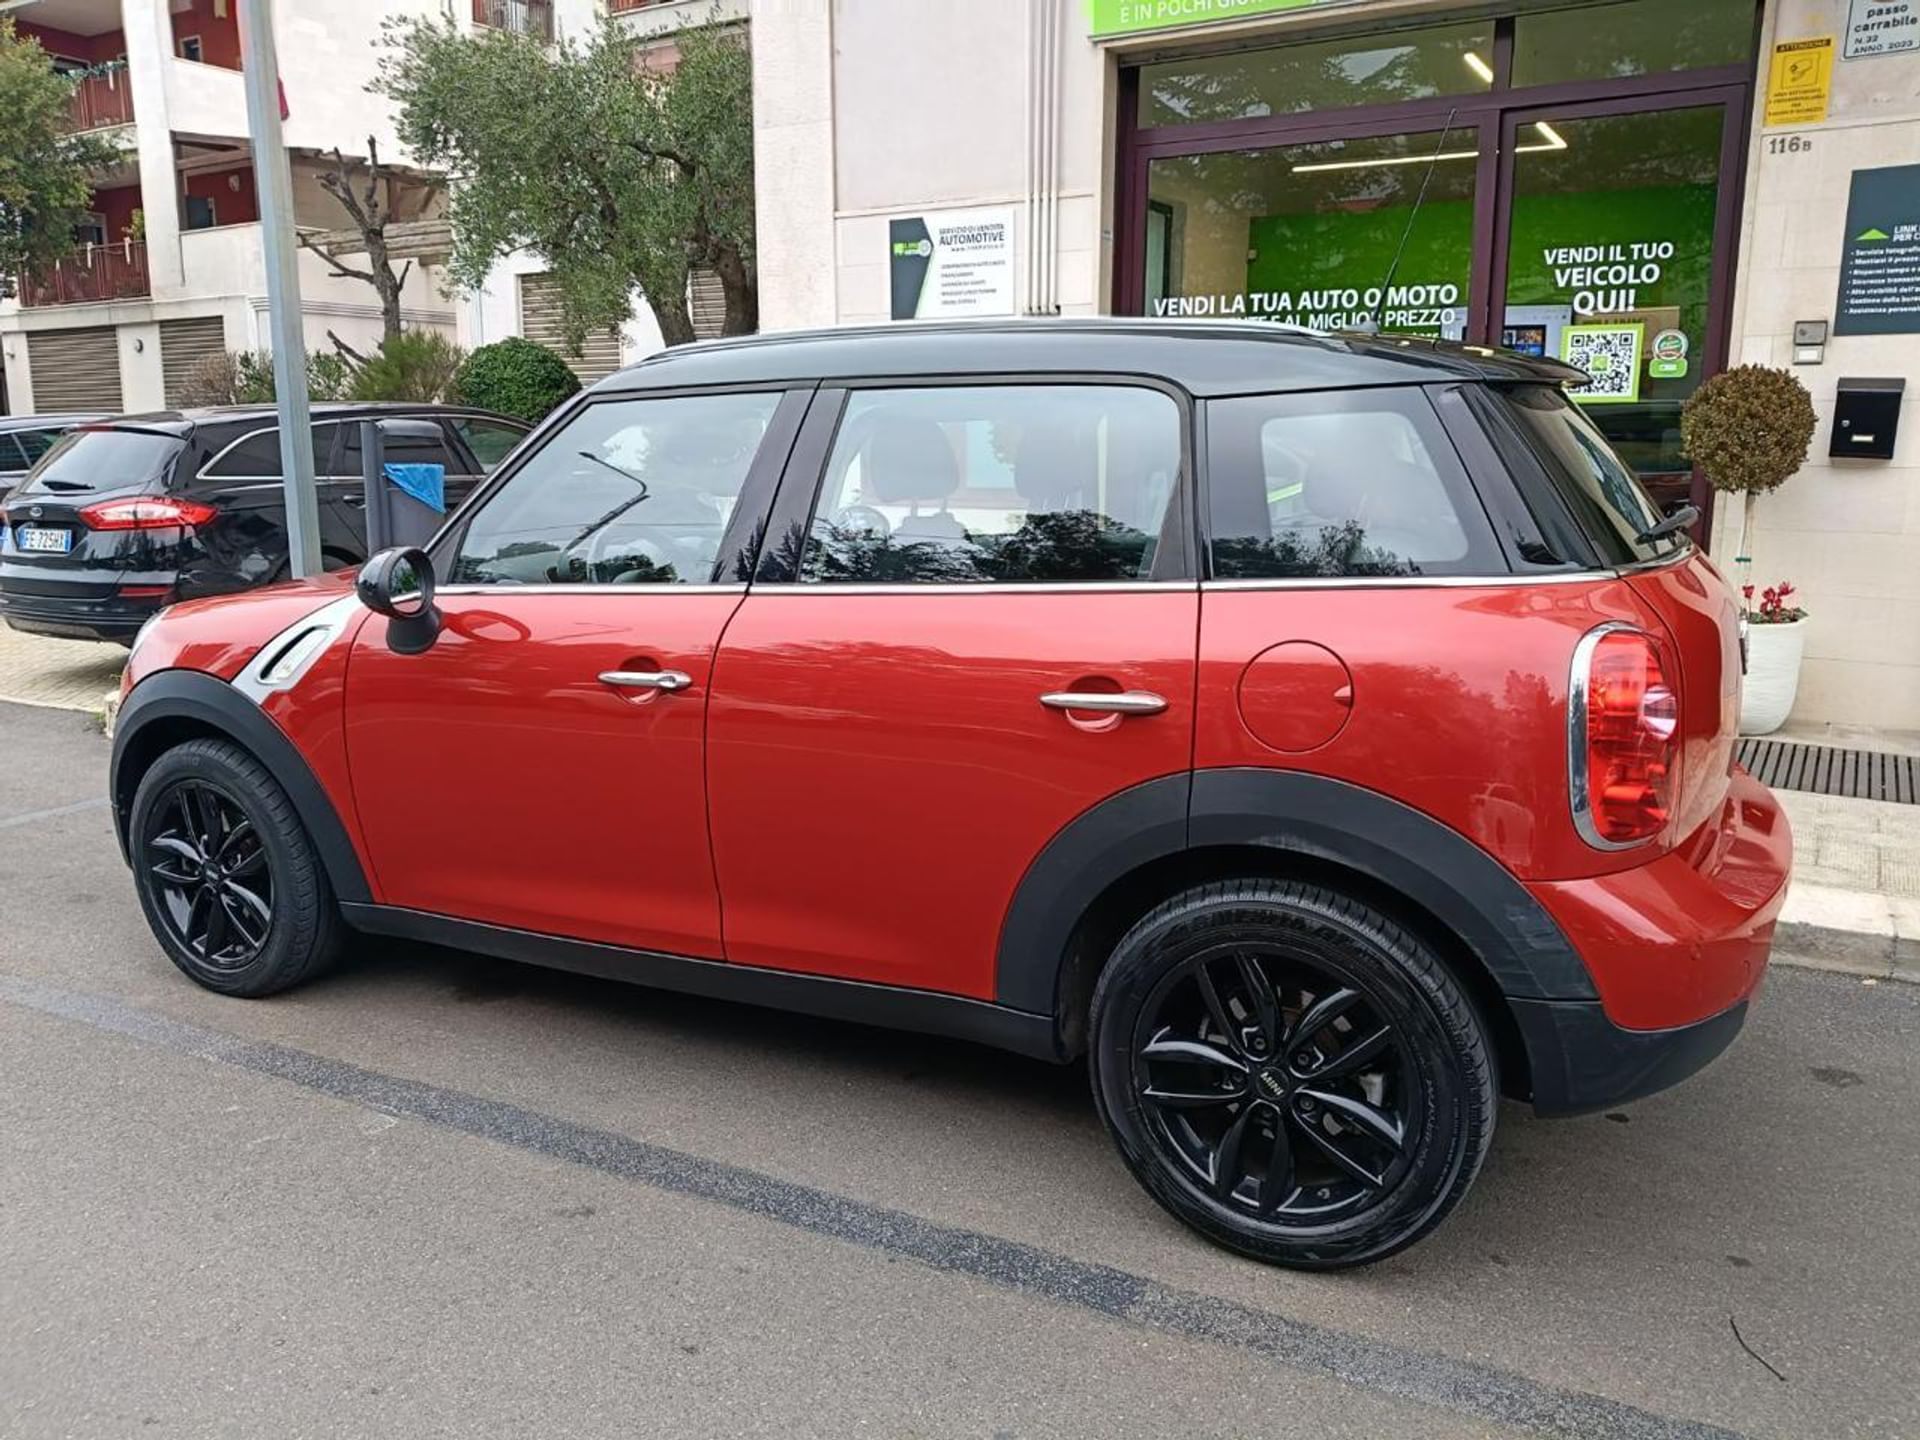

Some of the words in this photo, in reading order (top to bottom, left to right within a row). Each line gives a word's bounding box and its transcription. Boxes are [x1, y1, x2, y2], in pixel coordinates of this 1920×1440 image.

[1120, 6, 1129, 24] E
[1134, 3, 1152, 22] IN
[1867, 4, 1908, 19] passo
[1854, 16, 1918, 33] carrabile
[1853, 44, 1882, 54] ANNO
[939, 231, 1004, 246] AUTOMOTIVE
[1545, 245, 1604, 265] VENDI
[1609, 244, 1627, 261] IL
[1629, 241, 1674, 260] TUO
[1554, 263, 1661, 288] VEICOLO
[1153, 295, 1215, 317] VENDI
[1220, 294, 1246, 314] LA
[1250, 291, 1293, 313] TUA
[1298, 288, 1359, 311] AUTO
[1363, 287, 1382, 308] O
[1387, 283, 1458, 307] MOTO
[1573, 289, 1636, 316] QUI!
[1384, 308, 1455, 327] PREZZO
[1260, 1071, 1284, 1096] MINI
